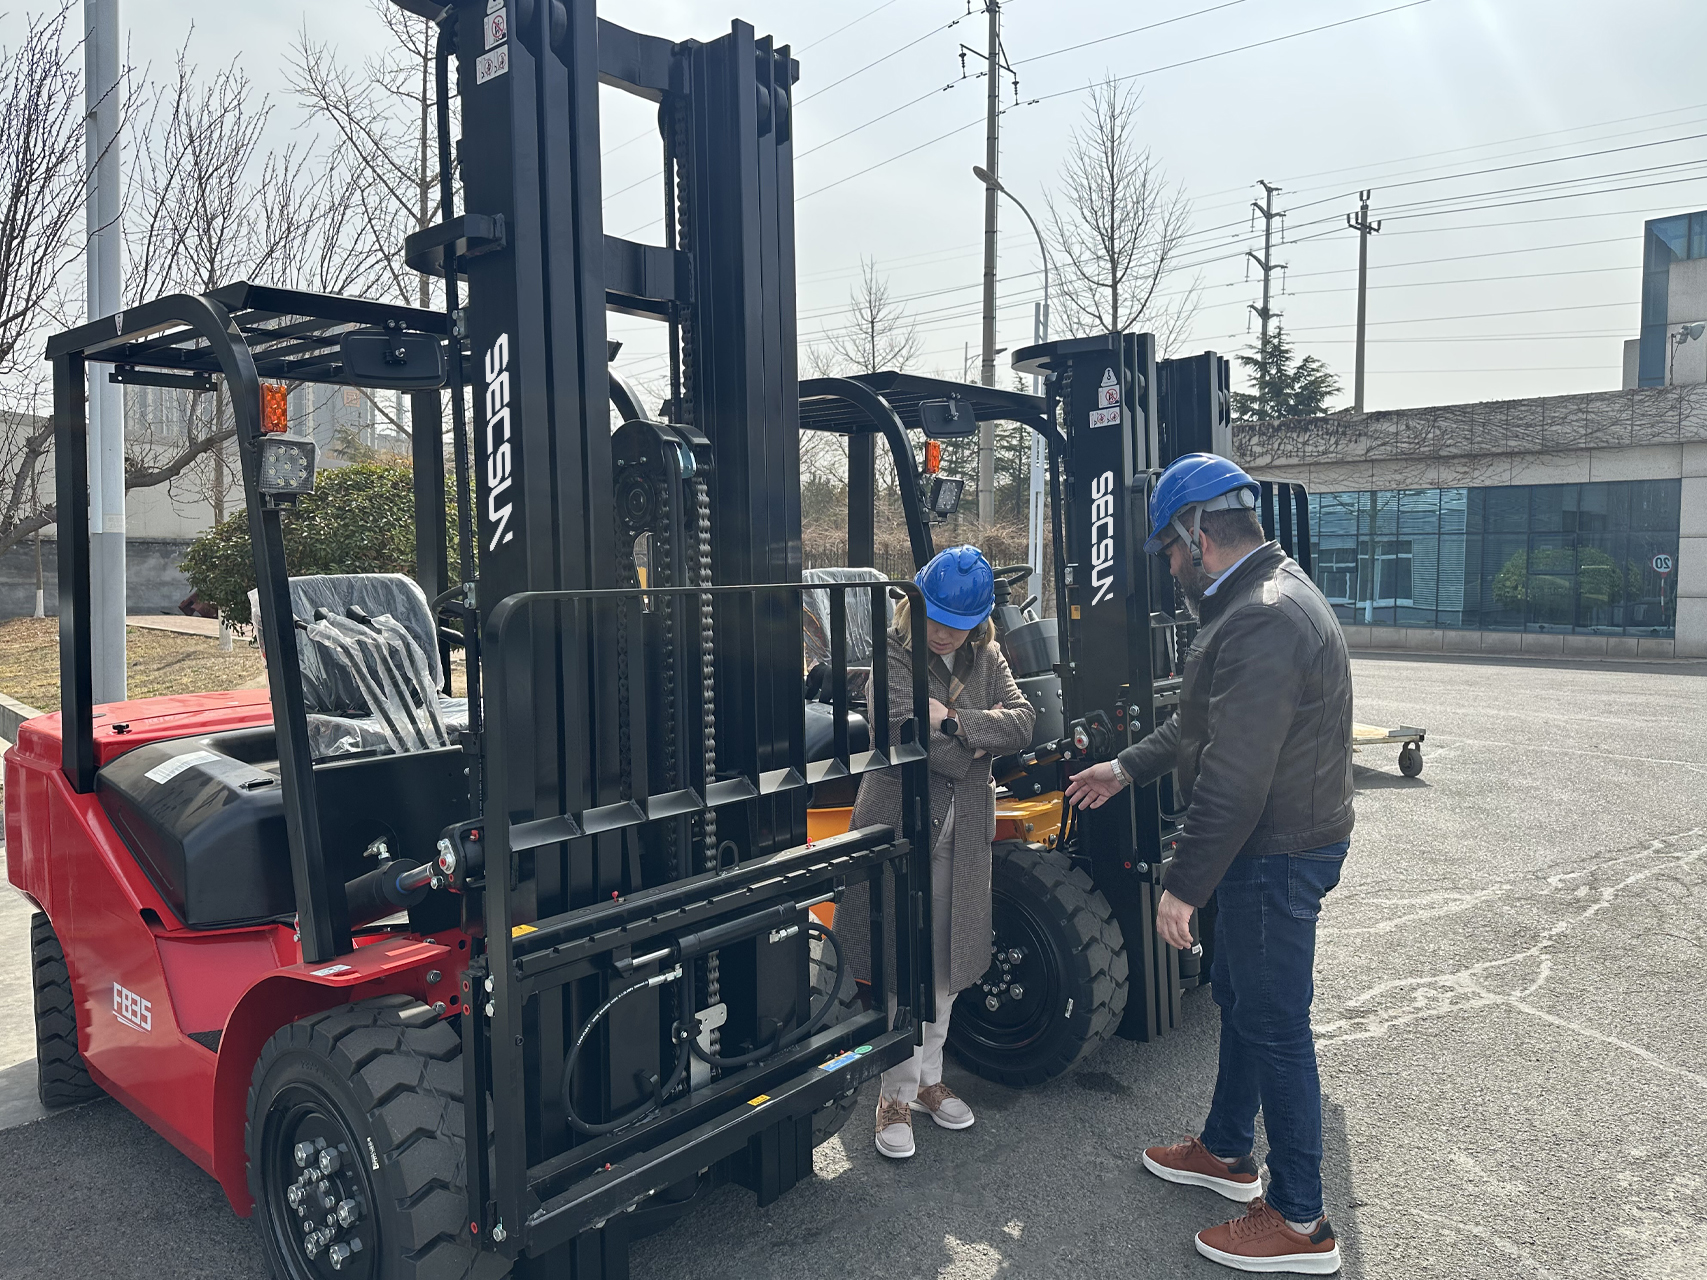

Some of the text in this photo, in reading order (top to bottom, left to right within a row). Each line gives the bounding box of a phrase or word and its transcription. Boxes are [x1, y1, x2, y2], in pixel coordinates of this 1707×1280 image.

[485, 332, 514, 552] SECSUN
[1091, 470, 1114, 607] SECSUN
[113, 981, 152, 1031] FB35
